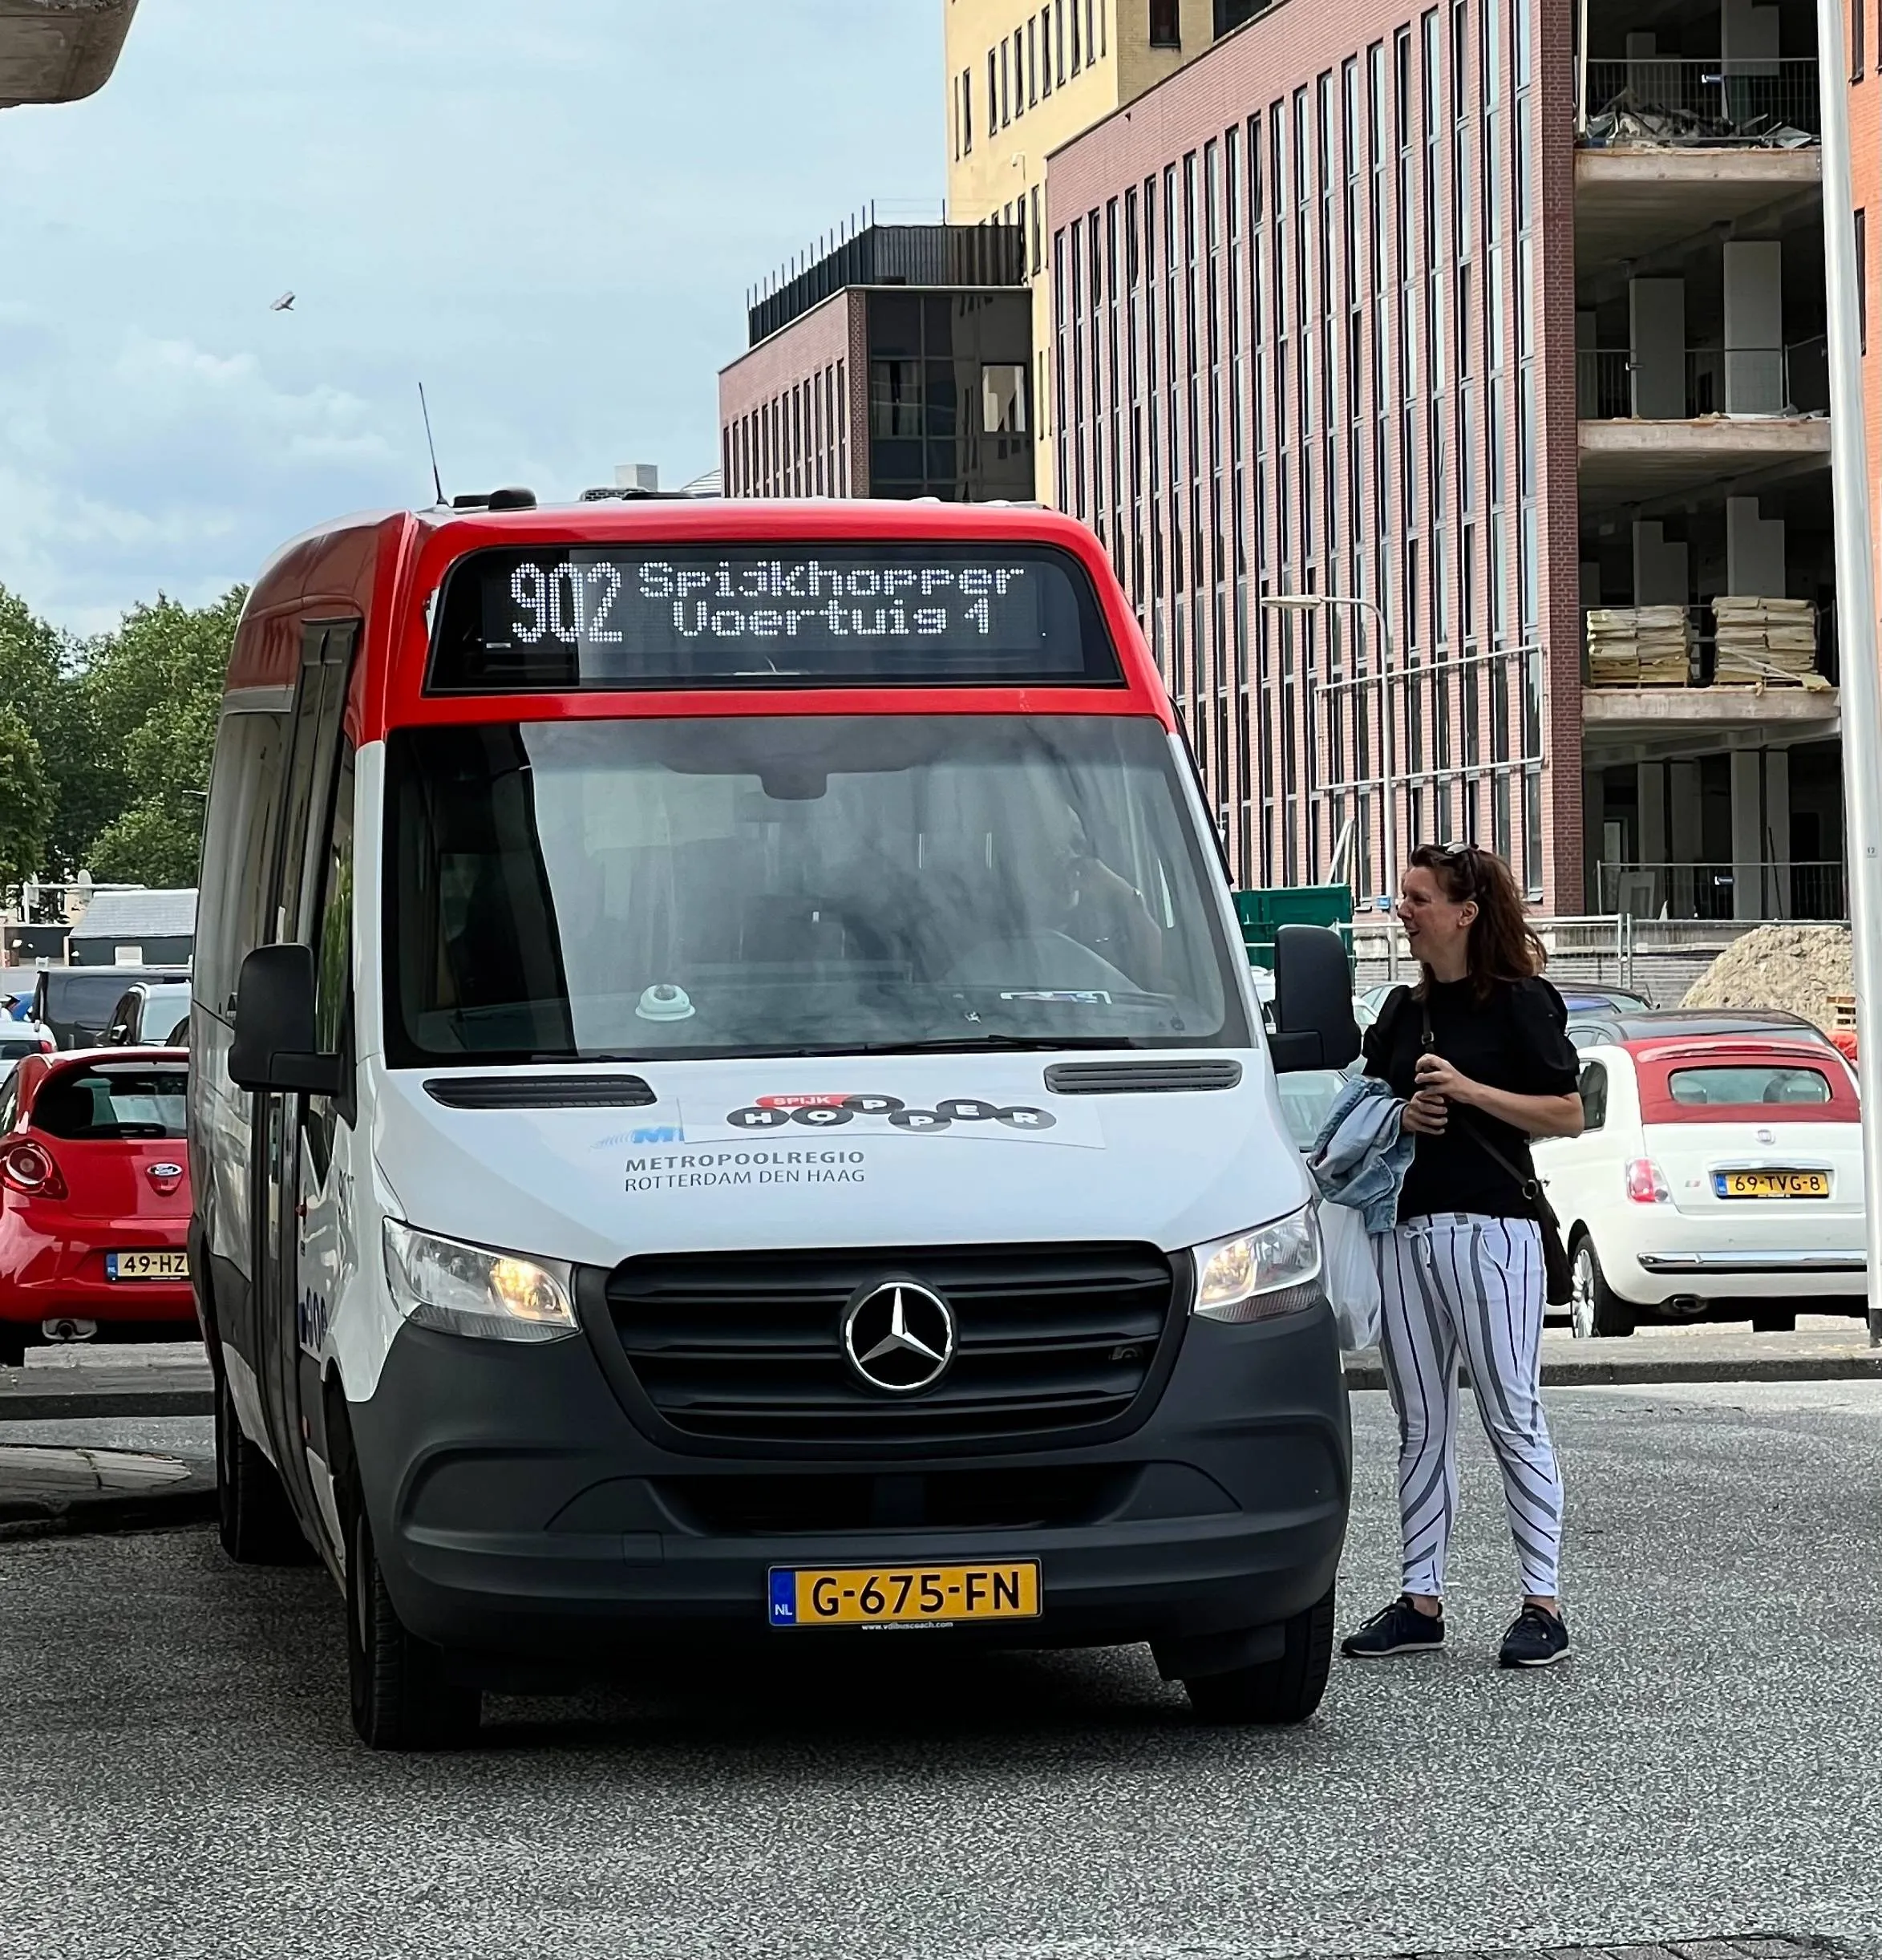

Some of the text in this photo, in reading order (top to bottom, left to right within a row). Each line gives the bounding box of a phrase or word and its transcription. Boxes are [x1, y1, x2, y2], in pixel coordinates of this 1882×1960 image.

[509, 561, 624, 644] 902
[964, 598, 990, 637] 1
[744, 1098, 1040, 1127] HOPPER
[772, 1095, 831, 1107] SPIJK
[625, 1150, 865, 1173] METROPOOLREGIO
[625, 1168, 865, 1193] ROTTERDAM DEN HAAG
[1734, 1176, 1820, 1191] 69-TVG-8
[123, 1255, 185, 1274] 49-HZ
[811, 1571, 1020, 1617] G-675-FN
[774, 1603, 793, 1617] NL
